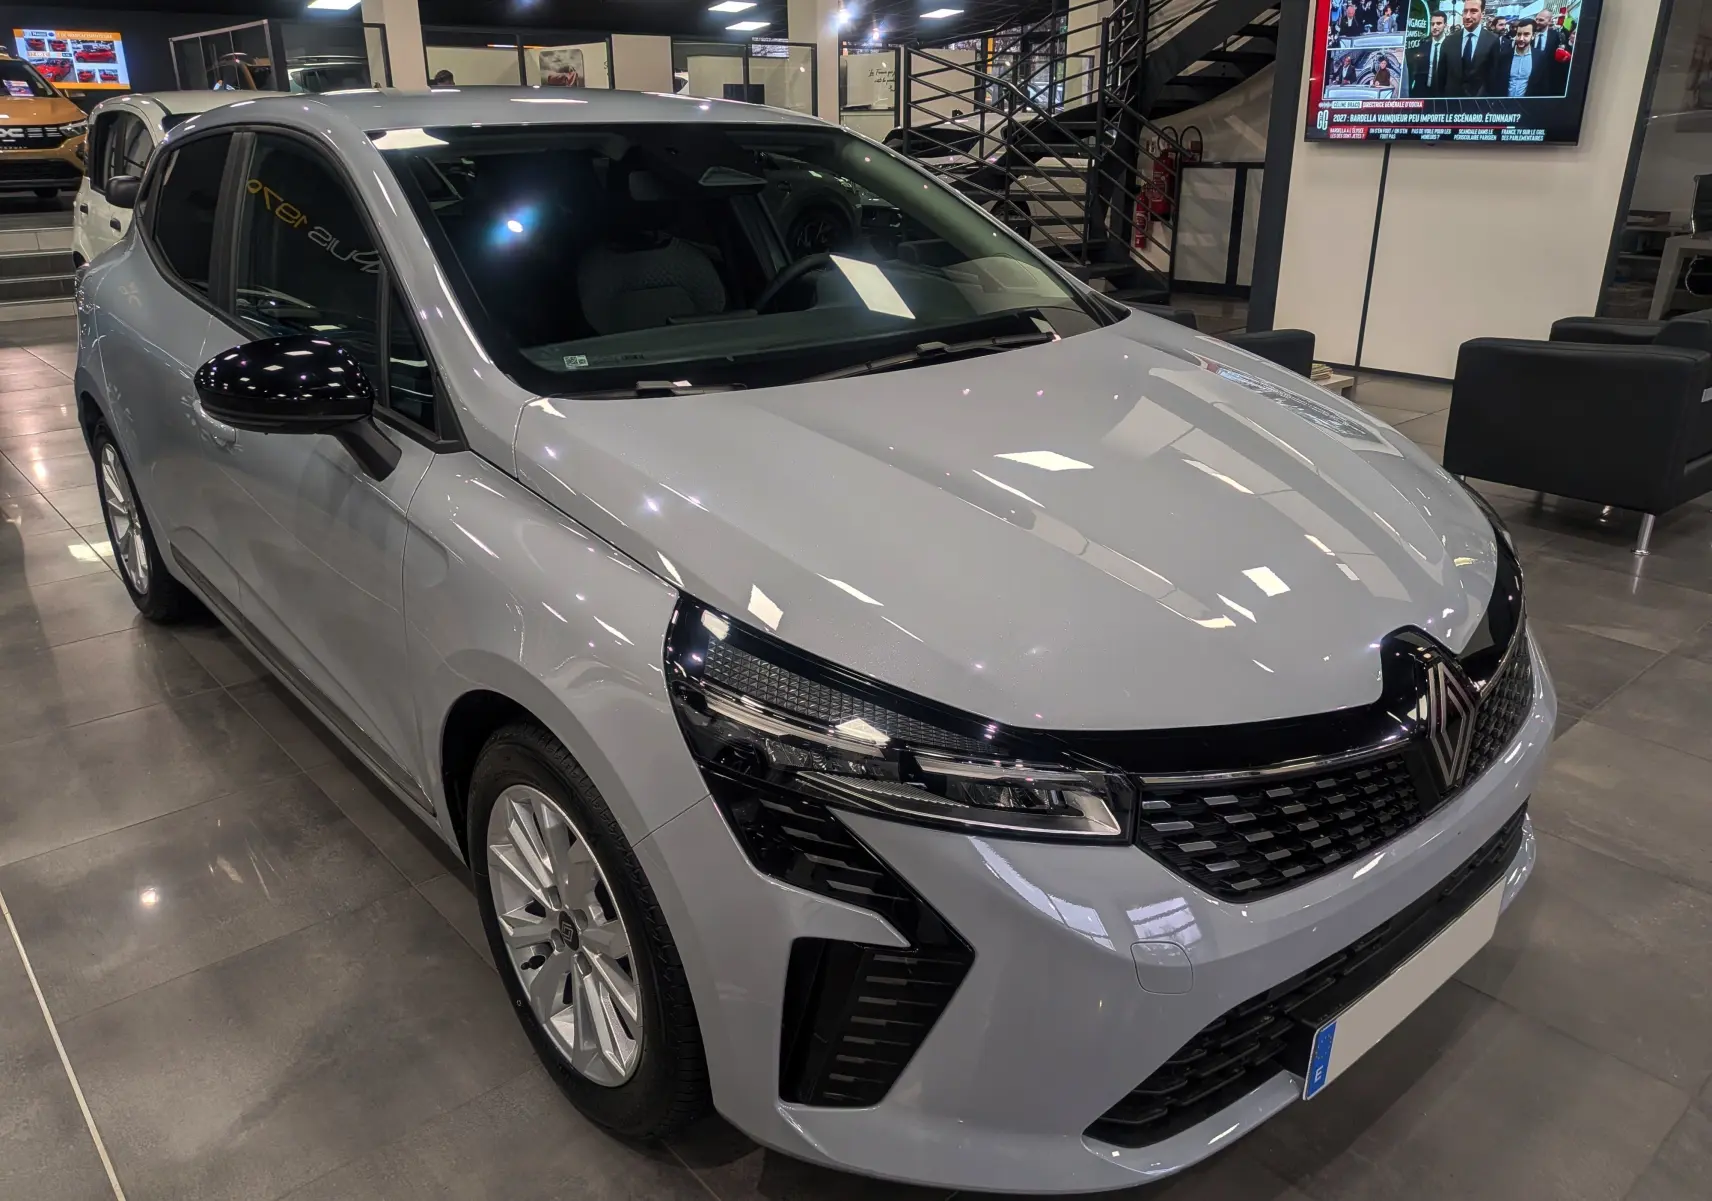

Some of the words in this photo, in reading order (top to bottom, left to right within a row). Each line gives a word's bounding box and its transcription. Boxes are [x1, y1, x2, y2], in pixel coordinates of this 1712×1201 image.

[1333, 114, 1347, 122] 2027
[1350, 114, 1376, 122] BARDELLA
[1378, 114, 1407, 124] VAINQUEUR
[1408, 114, 1420, 122] PEU
[1420, 114, 1445, 122] IMPORTE
[1446, 114, 1453, 122] LE
[1314, 1065, 1323, 1083] E
